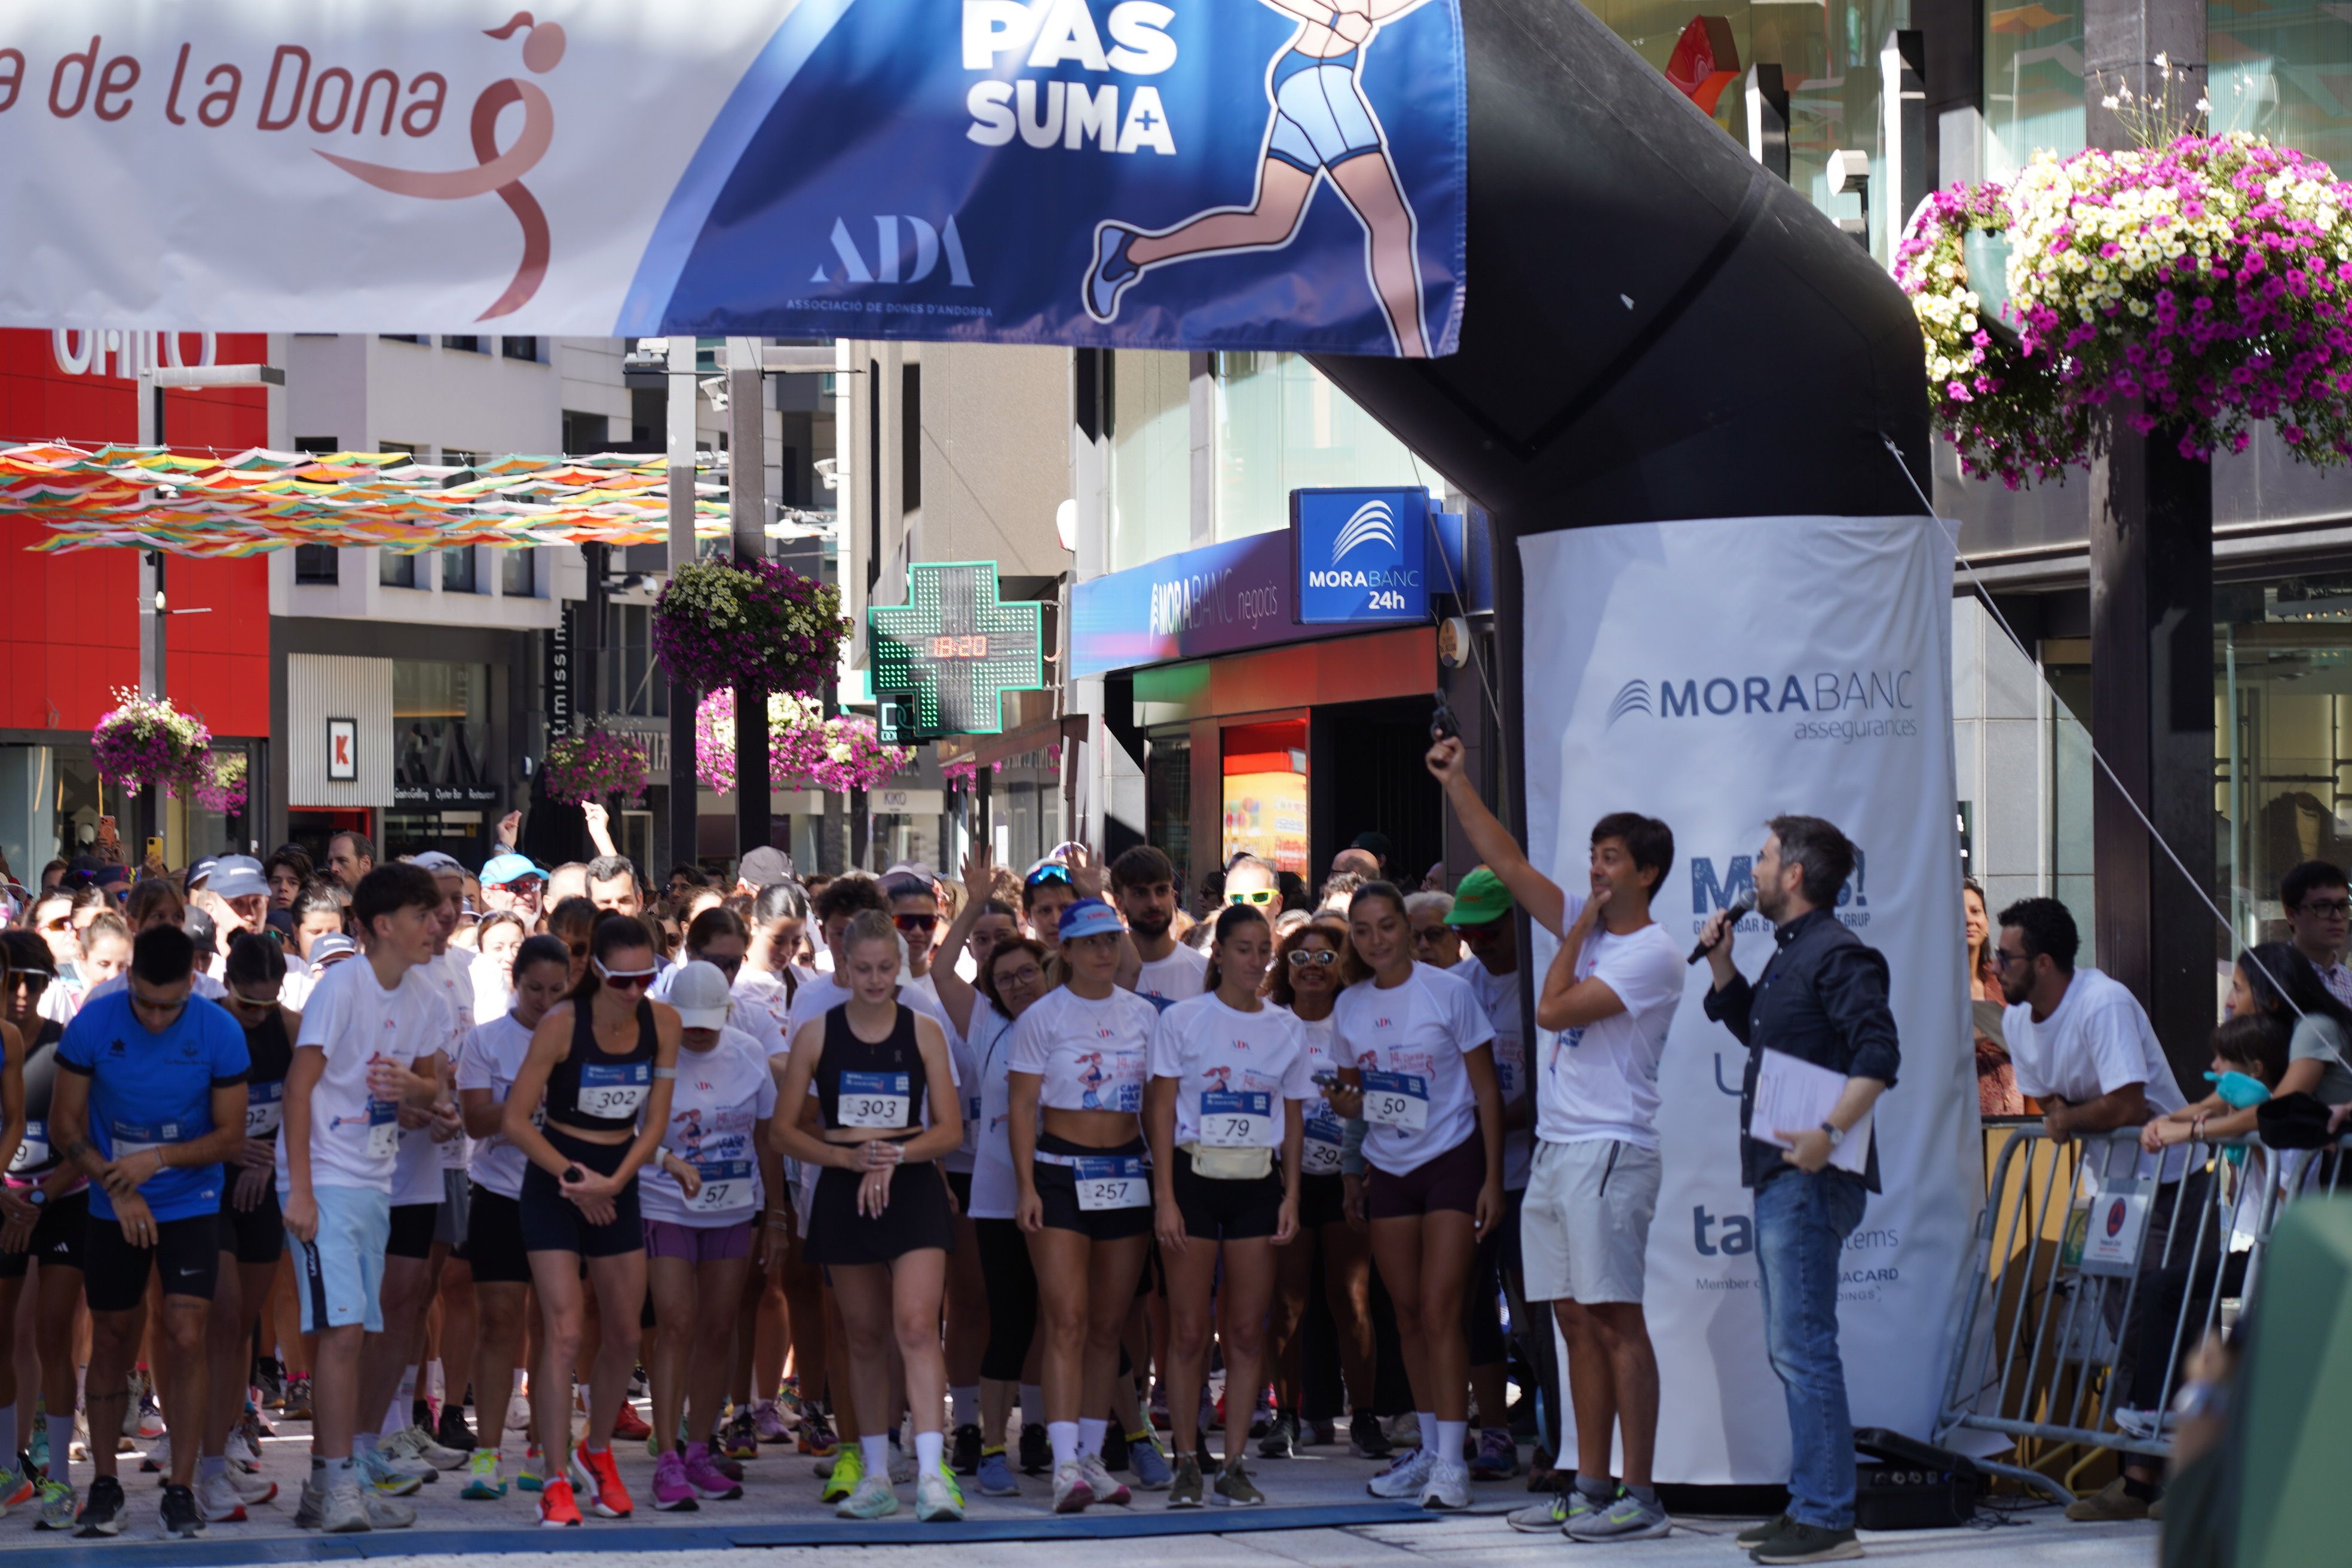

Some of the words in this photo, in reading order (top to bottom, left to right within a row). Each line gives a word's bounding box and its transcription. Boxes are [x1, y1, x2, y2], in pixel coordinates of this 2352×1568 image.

[961, 0, 1177, 75] PAS
[48, 35, 140, 121] de
[165, 42, 242, 127] la
[257, 44, 447, 137] Dona
[966, 79, 1177, 155] SUMA
[809, 213, 975, 287] ADA
[866, 302, 883, 313] DE
[886, 302, 924, 314] DONES
[927, 304, 993, 317] D'ANDORRA
[1309, 570, 1420, 587] MORABANC
[1158, 567, 1233, 636] MORABANC
[1238, 580, 1278, 630] negocis
[1368, 590, 1405, 610] 24h
[552, 610, 566, 737] timissim
[1660, 670, 1913, 718] MORABANC
[1794, 716, 1918, 745] assegurances
[335, 735, 349, 765] K
[884, 792, 907, 806] KIKO
[1844, 912, 1871, 927] GRUP
[598, 1091, 636, 1109] 302
[858, 1100, 896, 1118] 303
[1383, 1097, 1406, 1115] 50
[1226, 1119, 1250, 1137] 79
[705, 1184, 730, 1203] 57
[1095, 1182, 1129, 1200] 257
[1696, 1278, 1750, 1291] Member
[1839, 1267, 1899, 1284] ACARD
